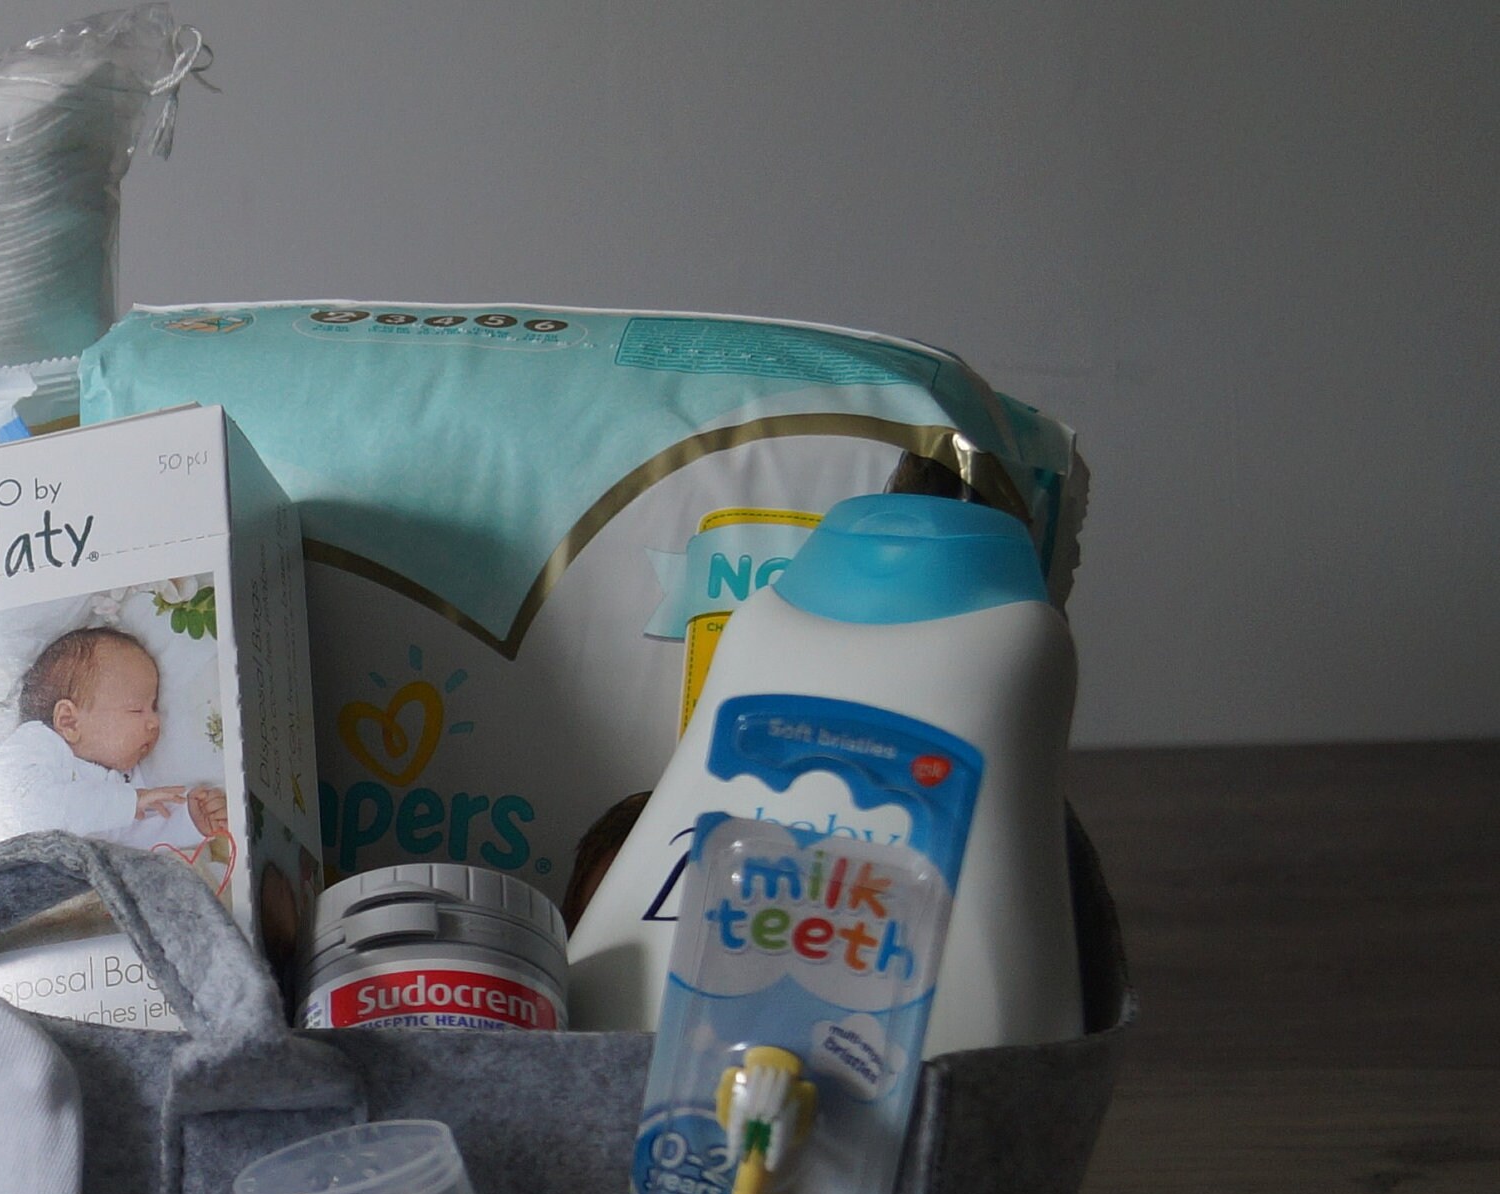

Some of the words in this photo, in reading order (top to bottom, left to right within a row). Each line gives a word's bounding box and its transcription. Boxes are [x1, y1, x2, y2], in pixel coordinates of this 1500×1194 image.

[158, 453, 182, 474] 50
[34, 477, 62, 504] by
[767, 717, 812, 743] Soft
[816, 729, 897, 760] bristles
[741, 850, 894, 918] milk
[706, 898, 916, 981] teeth
[357, 975, 538, 1025] Sudocrem
[651, 1132, 733, 1186] 0-2
